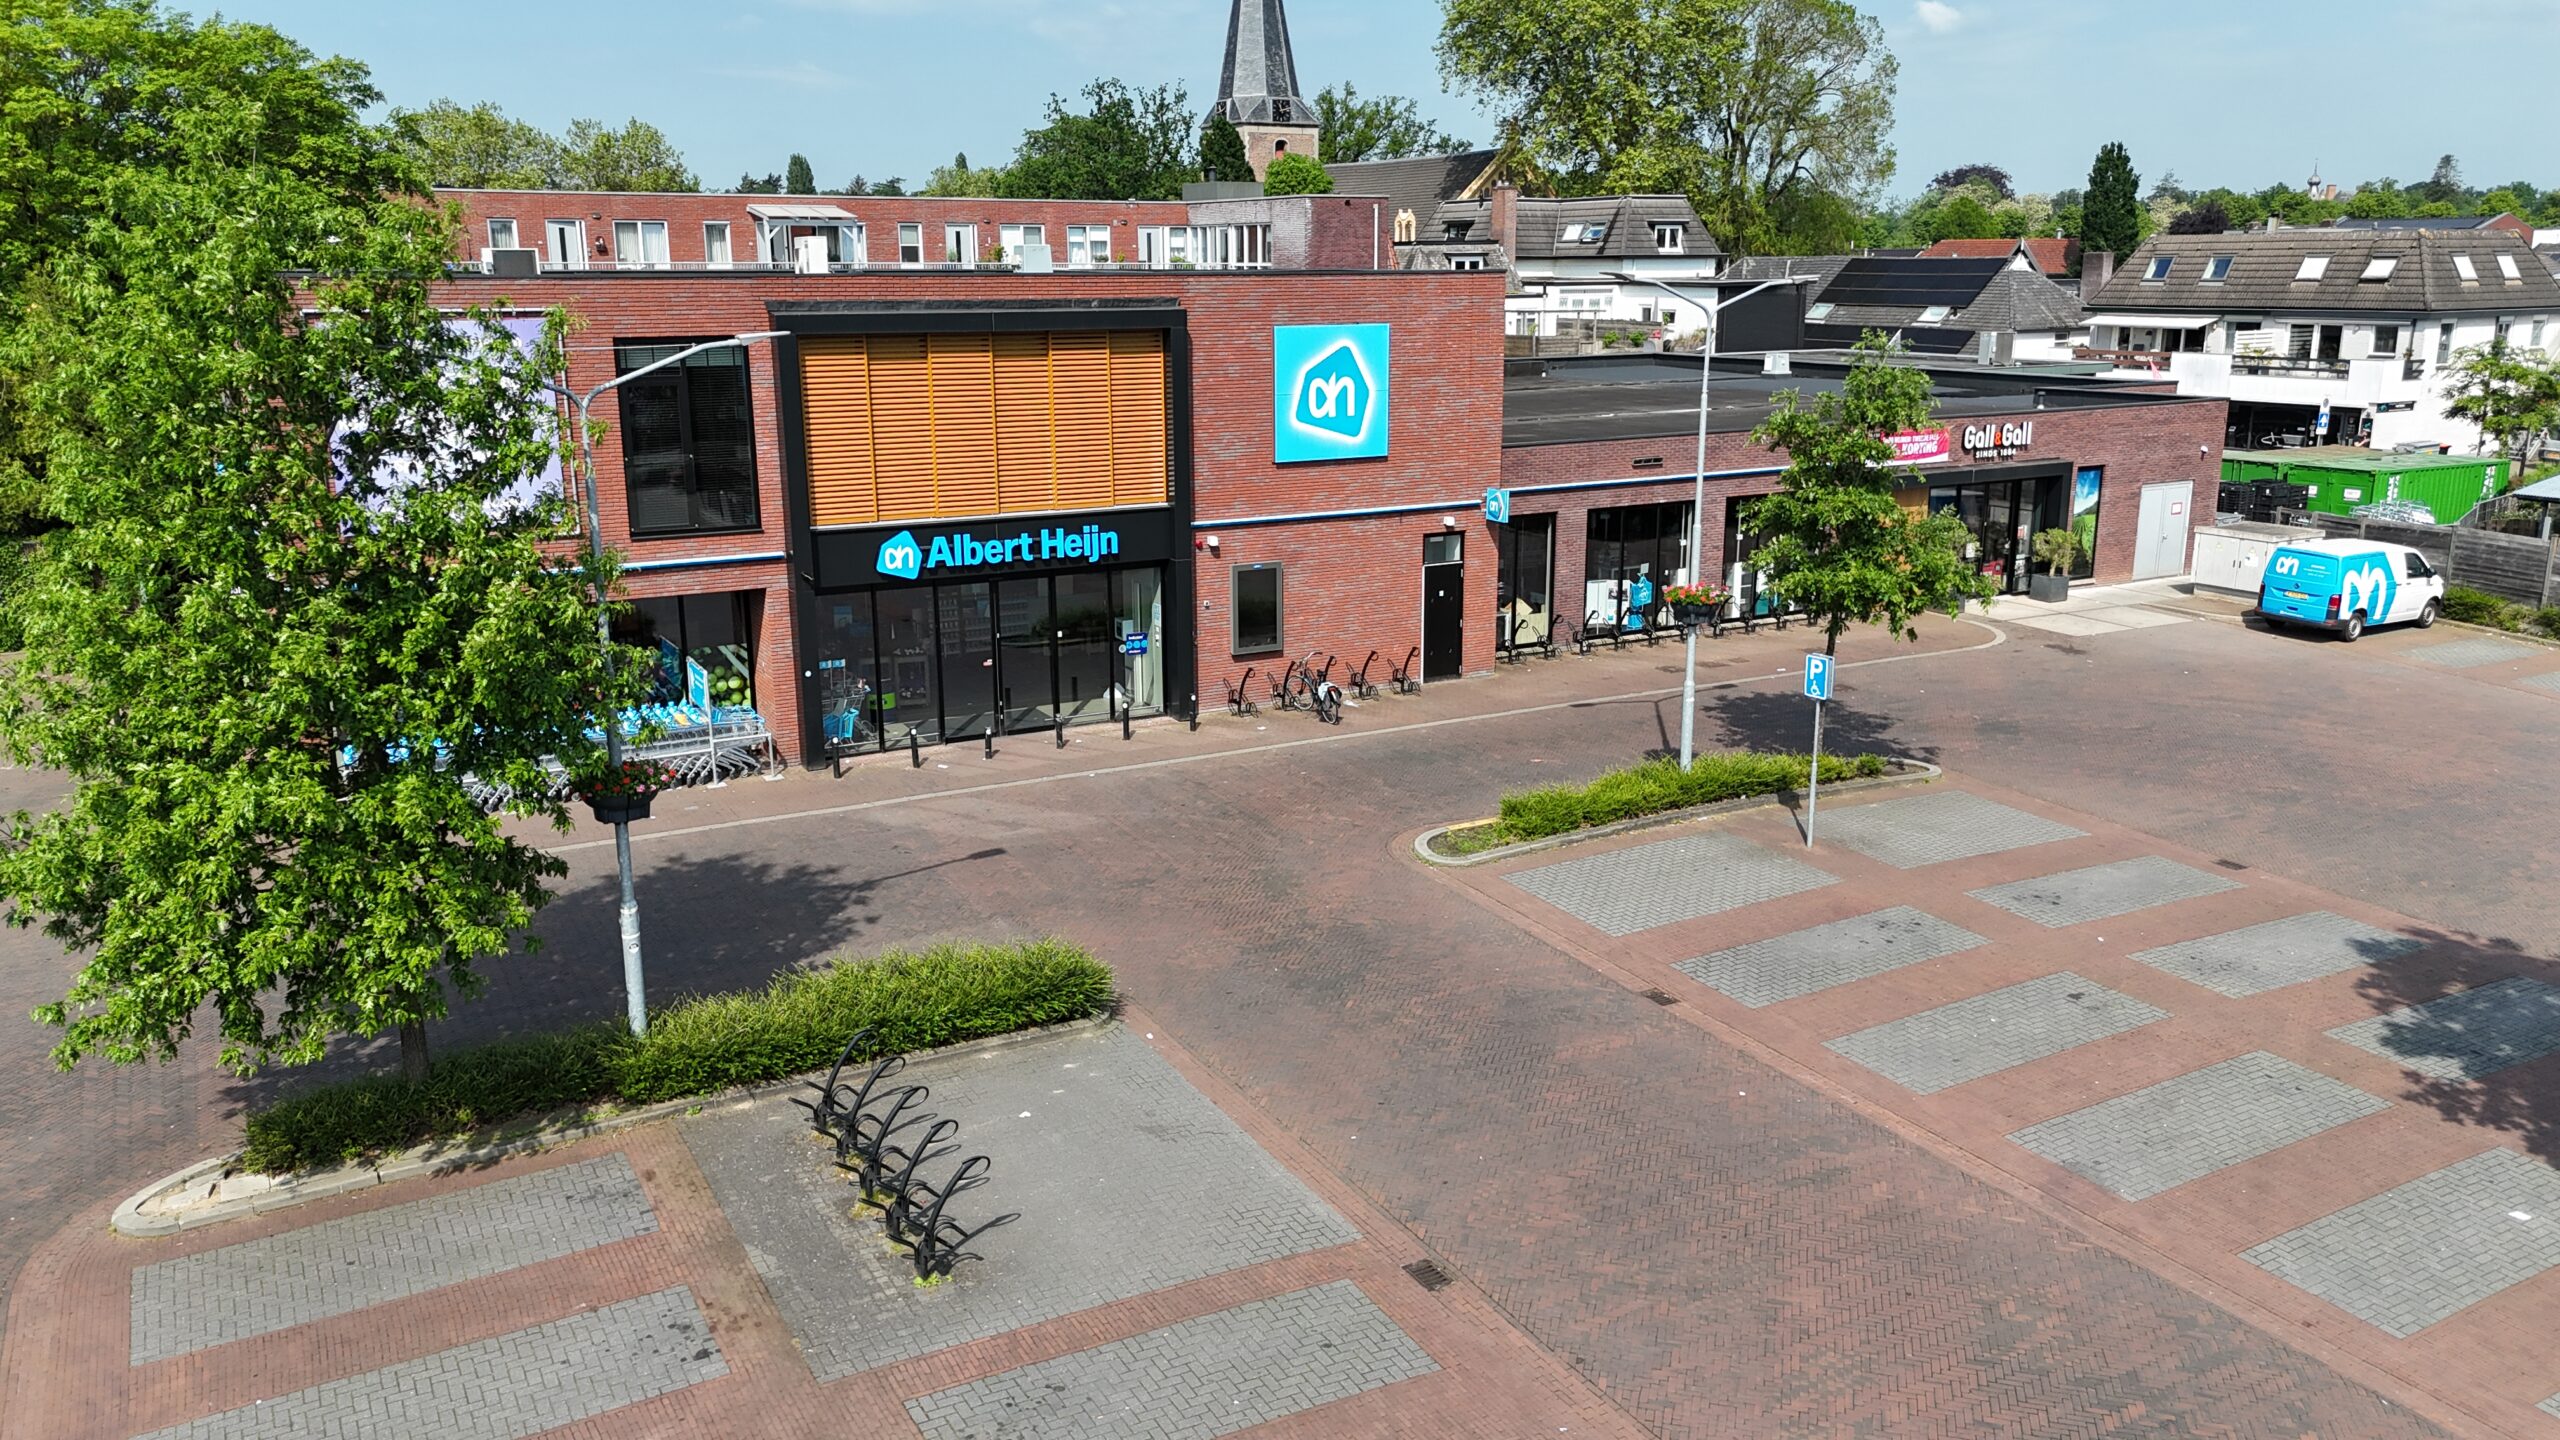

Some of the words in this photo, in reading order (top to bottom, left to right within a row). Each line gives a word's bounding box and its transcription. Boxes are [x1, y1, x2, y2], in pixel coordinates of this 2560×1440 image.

[1902, 441, 1938, 455] KORTING
[1975, 449, 1998, 459] SINDS
[2000, 447, 2017, 457] 1884
[926, 533, 1034, 569] Albert
[1040, 525, 1119, 563] Heijn
[1810, 659, 1823, 680] P
